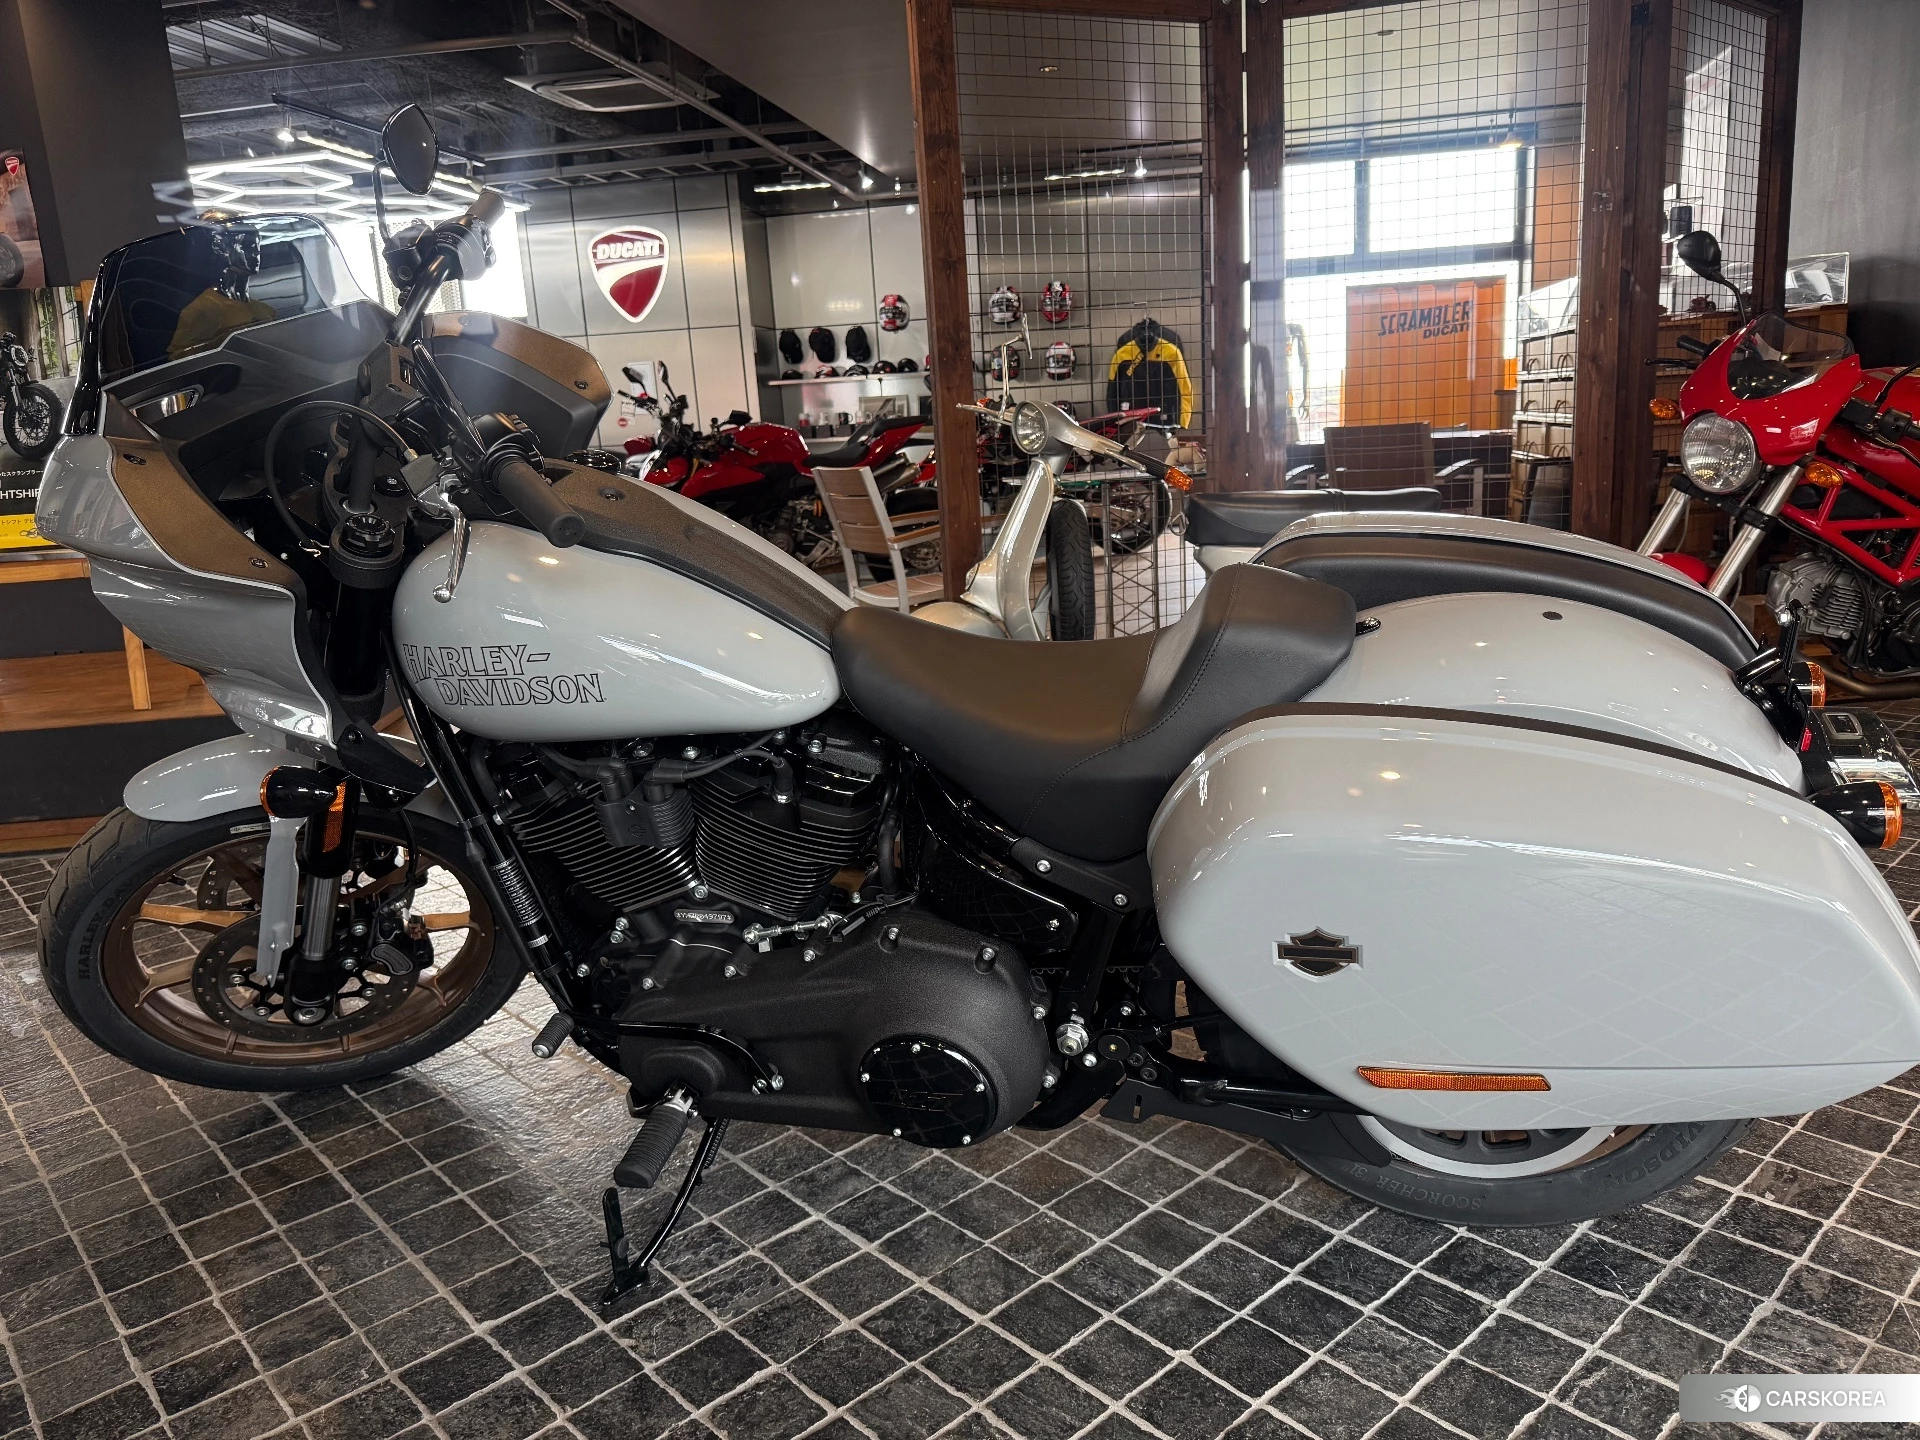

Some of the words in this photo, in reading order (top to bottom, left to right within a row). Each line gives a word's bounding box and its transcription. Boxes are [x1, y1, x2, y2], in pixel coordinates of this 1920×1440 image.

[596, 240, 660, 260] DUCATI
[1378, 300, 1471, 337] SCRAMBLER
[1423, 322, 1470, 339] DUCATI
[403, 644, 550, 683] HARLEY-
[435, 673, 606, 706] DAVIDSON
[1375, 1174, 1482, 1210] SCORCHER
